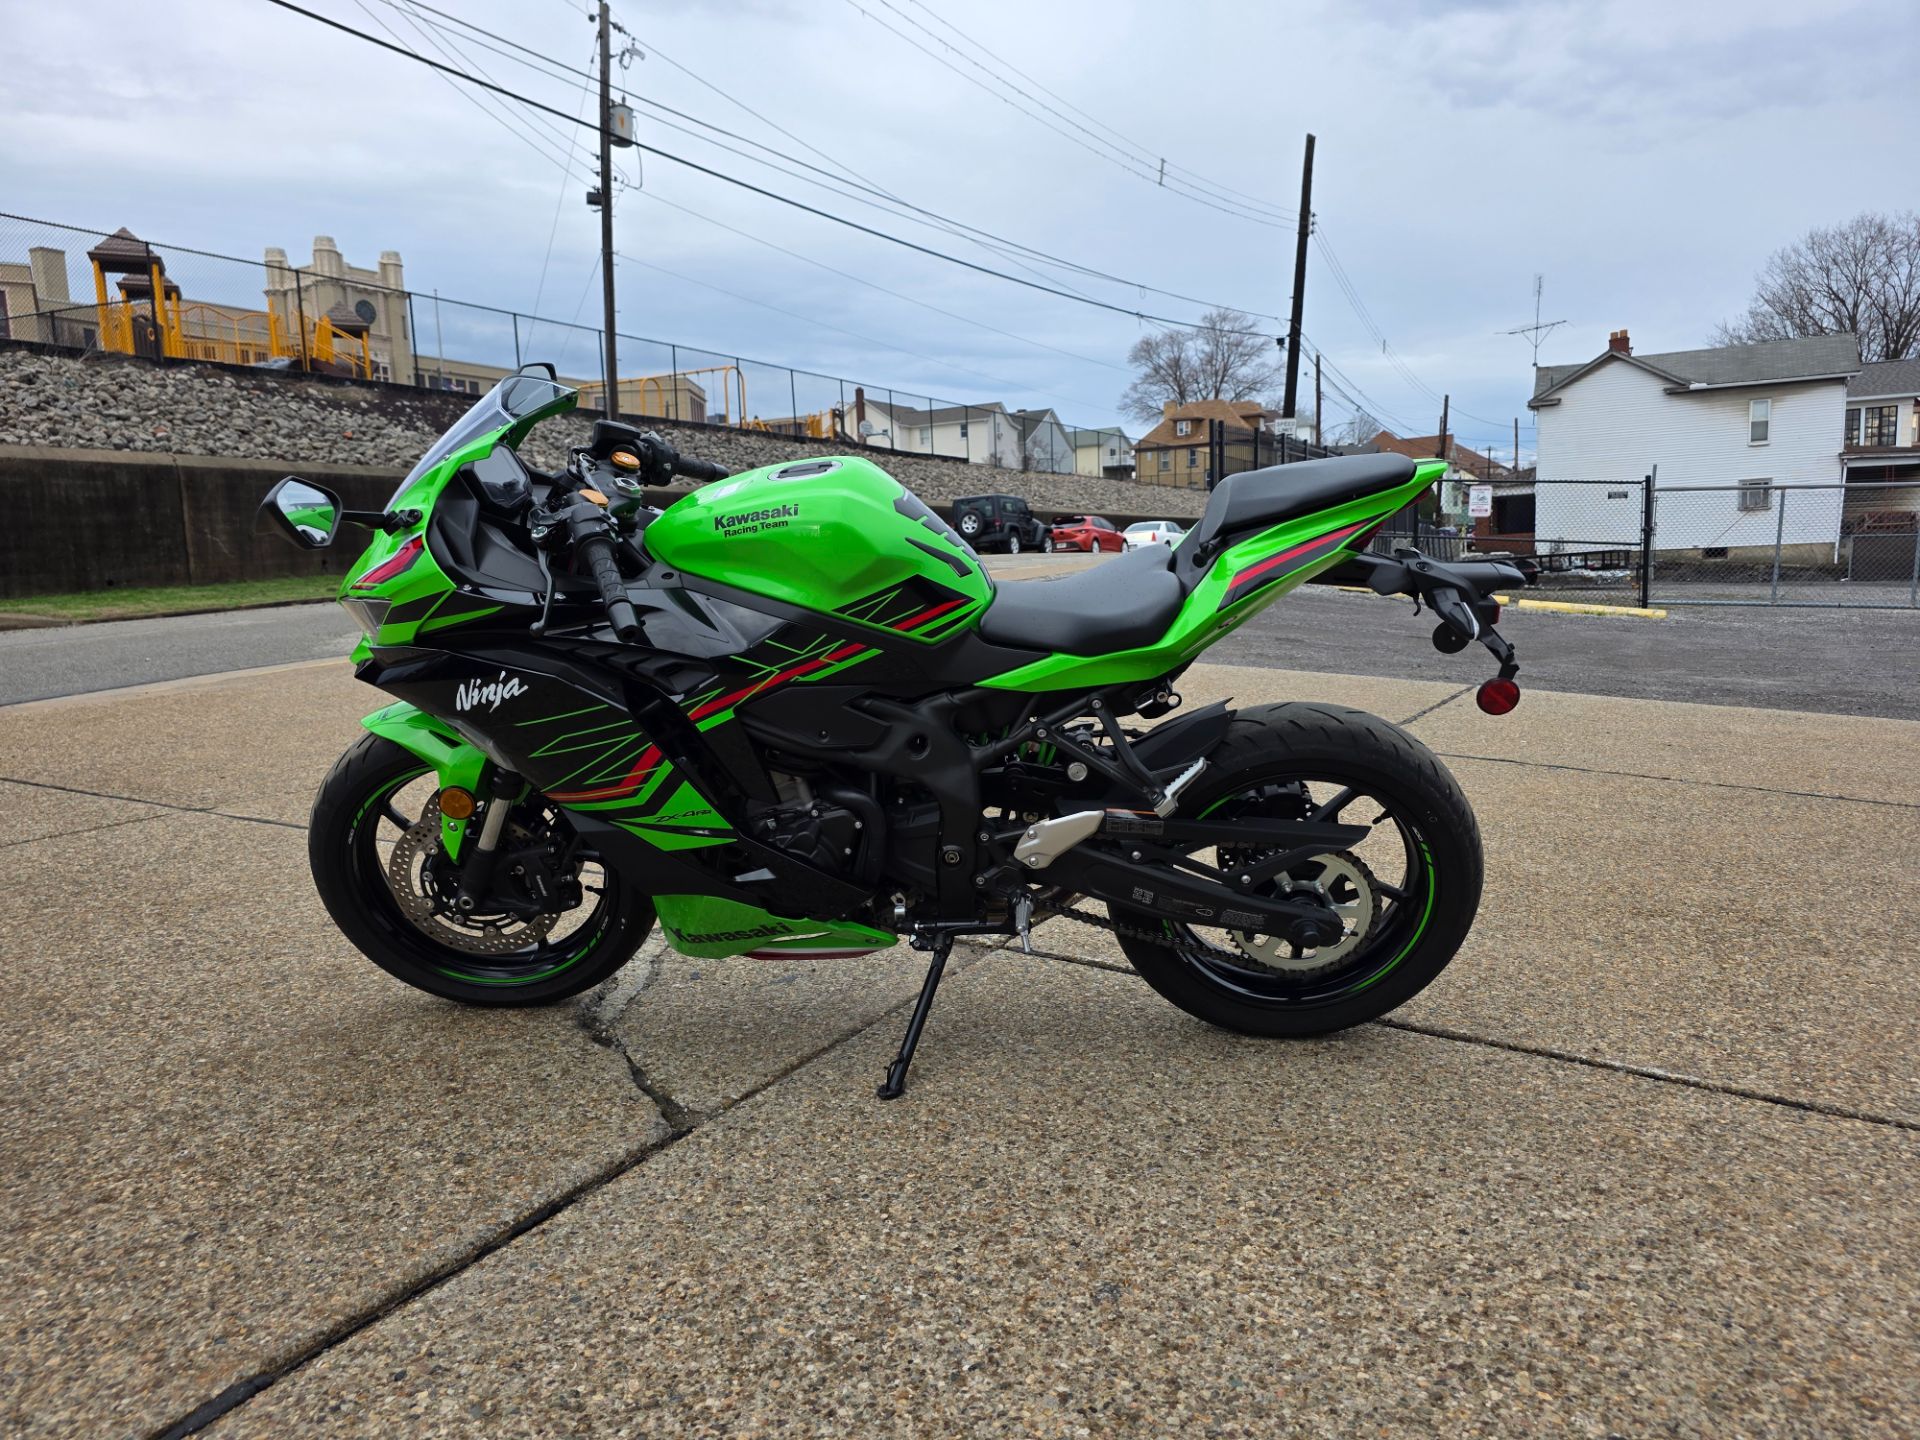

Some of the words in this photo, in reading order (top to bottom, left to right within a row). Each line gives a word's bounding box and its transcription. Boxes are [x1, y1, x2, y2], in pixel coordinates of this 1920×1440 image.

[714, 503, 799, 531] Kawasaki
[724, 524, 758, 538] Racing
[760, 520, 789, 530] Team
[456, 670, 529, 713] Ninja
[668, 922, 795, 944] Kawasaki
